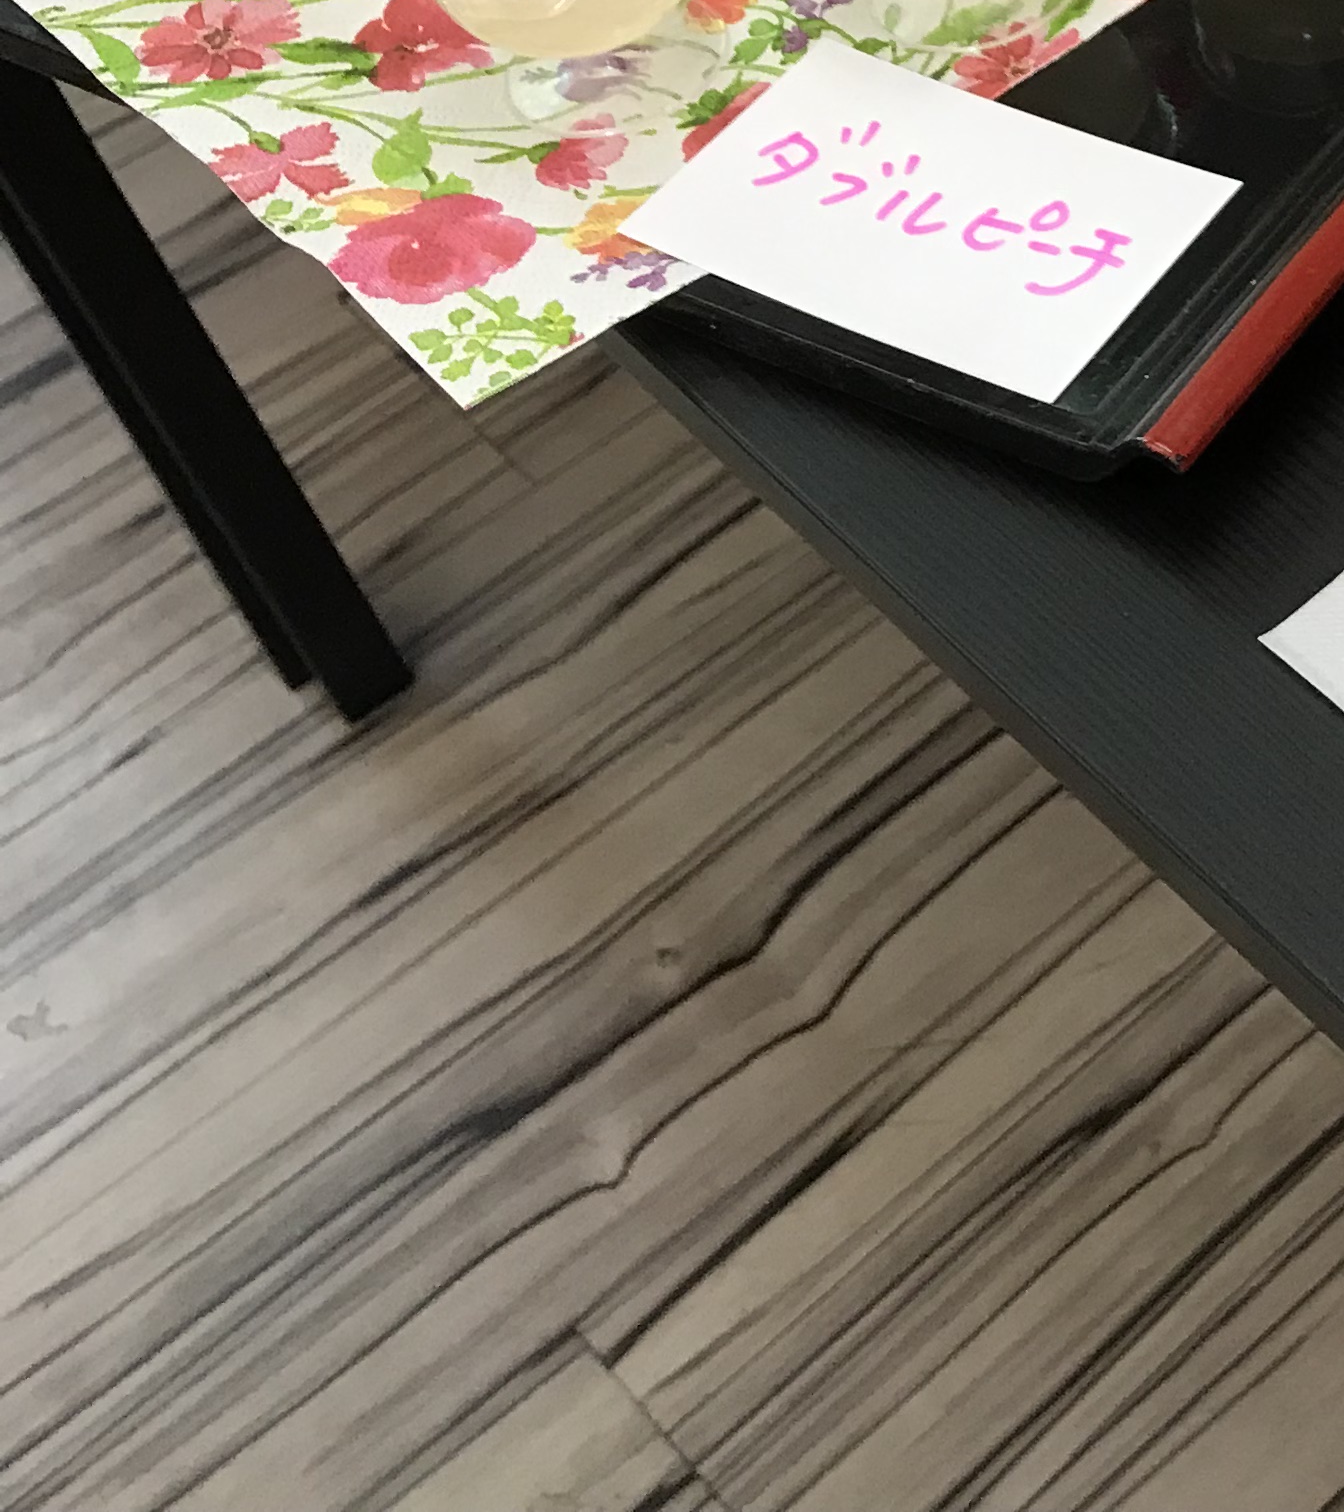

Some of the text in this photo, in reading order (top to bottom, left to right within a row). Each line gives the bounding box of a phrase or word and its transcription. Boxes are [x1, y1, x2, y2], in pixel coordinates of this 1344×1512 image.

[750, 120, 1133, 298] ダブルピーチ
